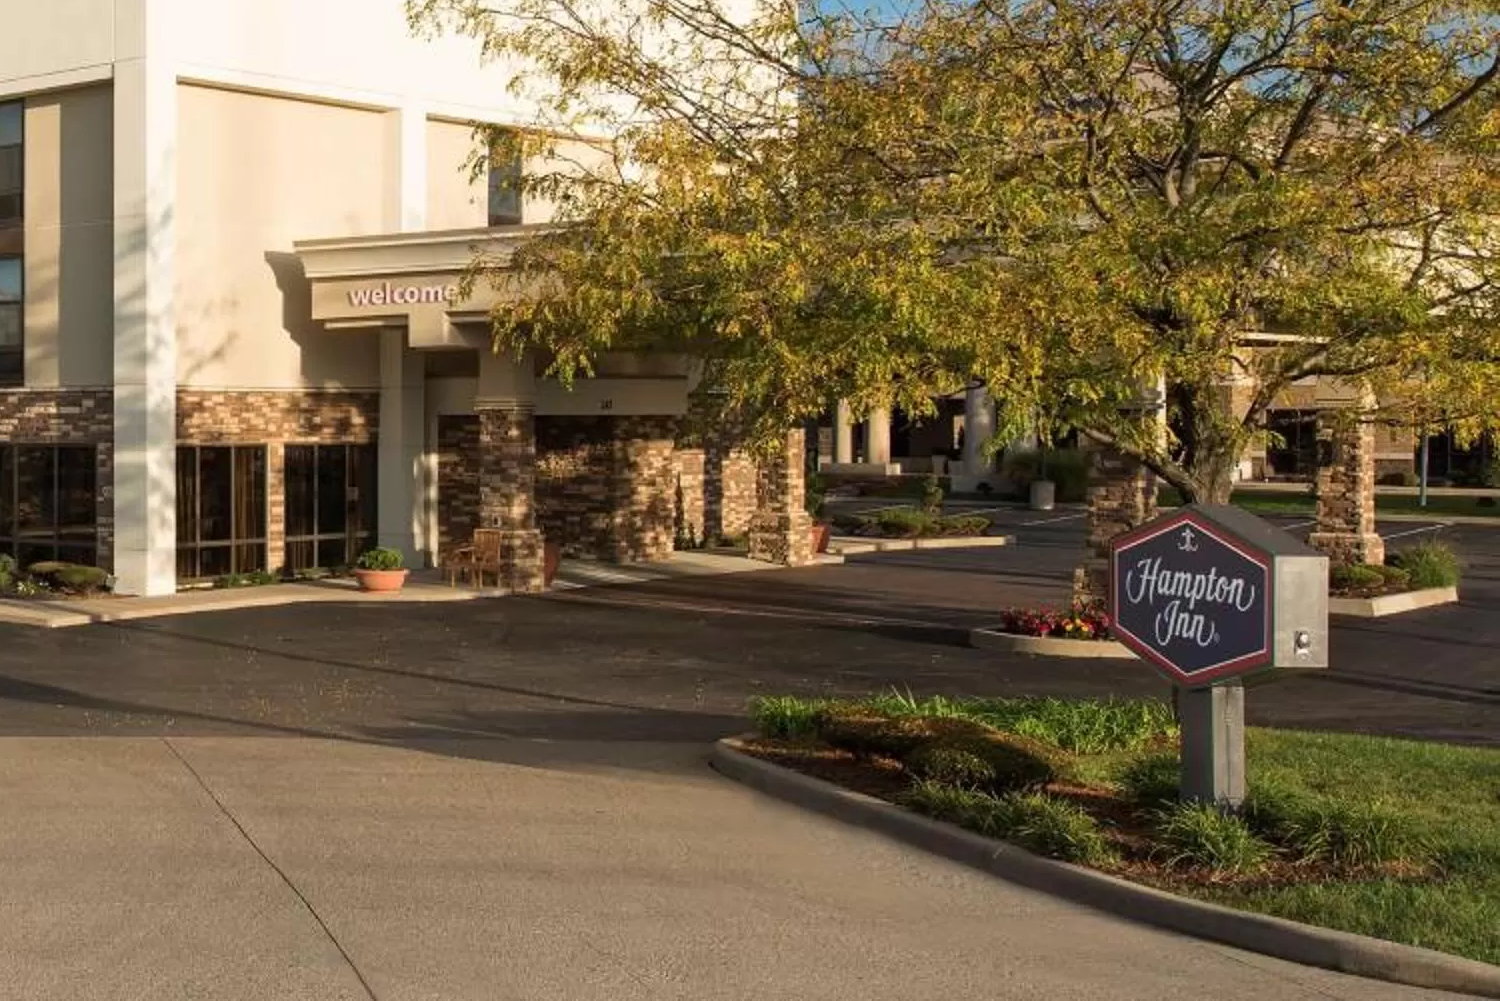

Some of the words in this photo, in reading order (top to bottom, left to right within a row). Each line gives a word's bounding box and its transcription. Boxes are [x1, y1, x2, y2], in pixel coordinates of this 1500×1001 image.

[348, 282, 458, 307] welcome
[1126, 556, 1255, 612] Hampton
[1155, 600, 1216, 647] Inn
